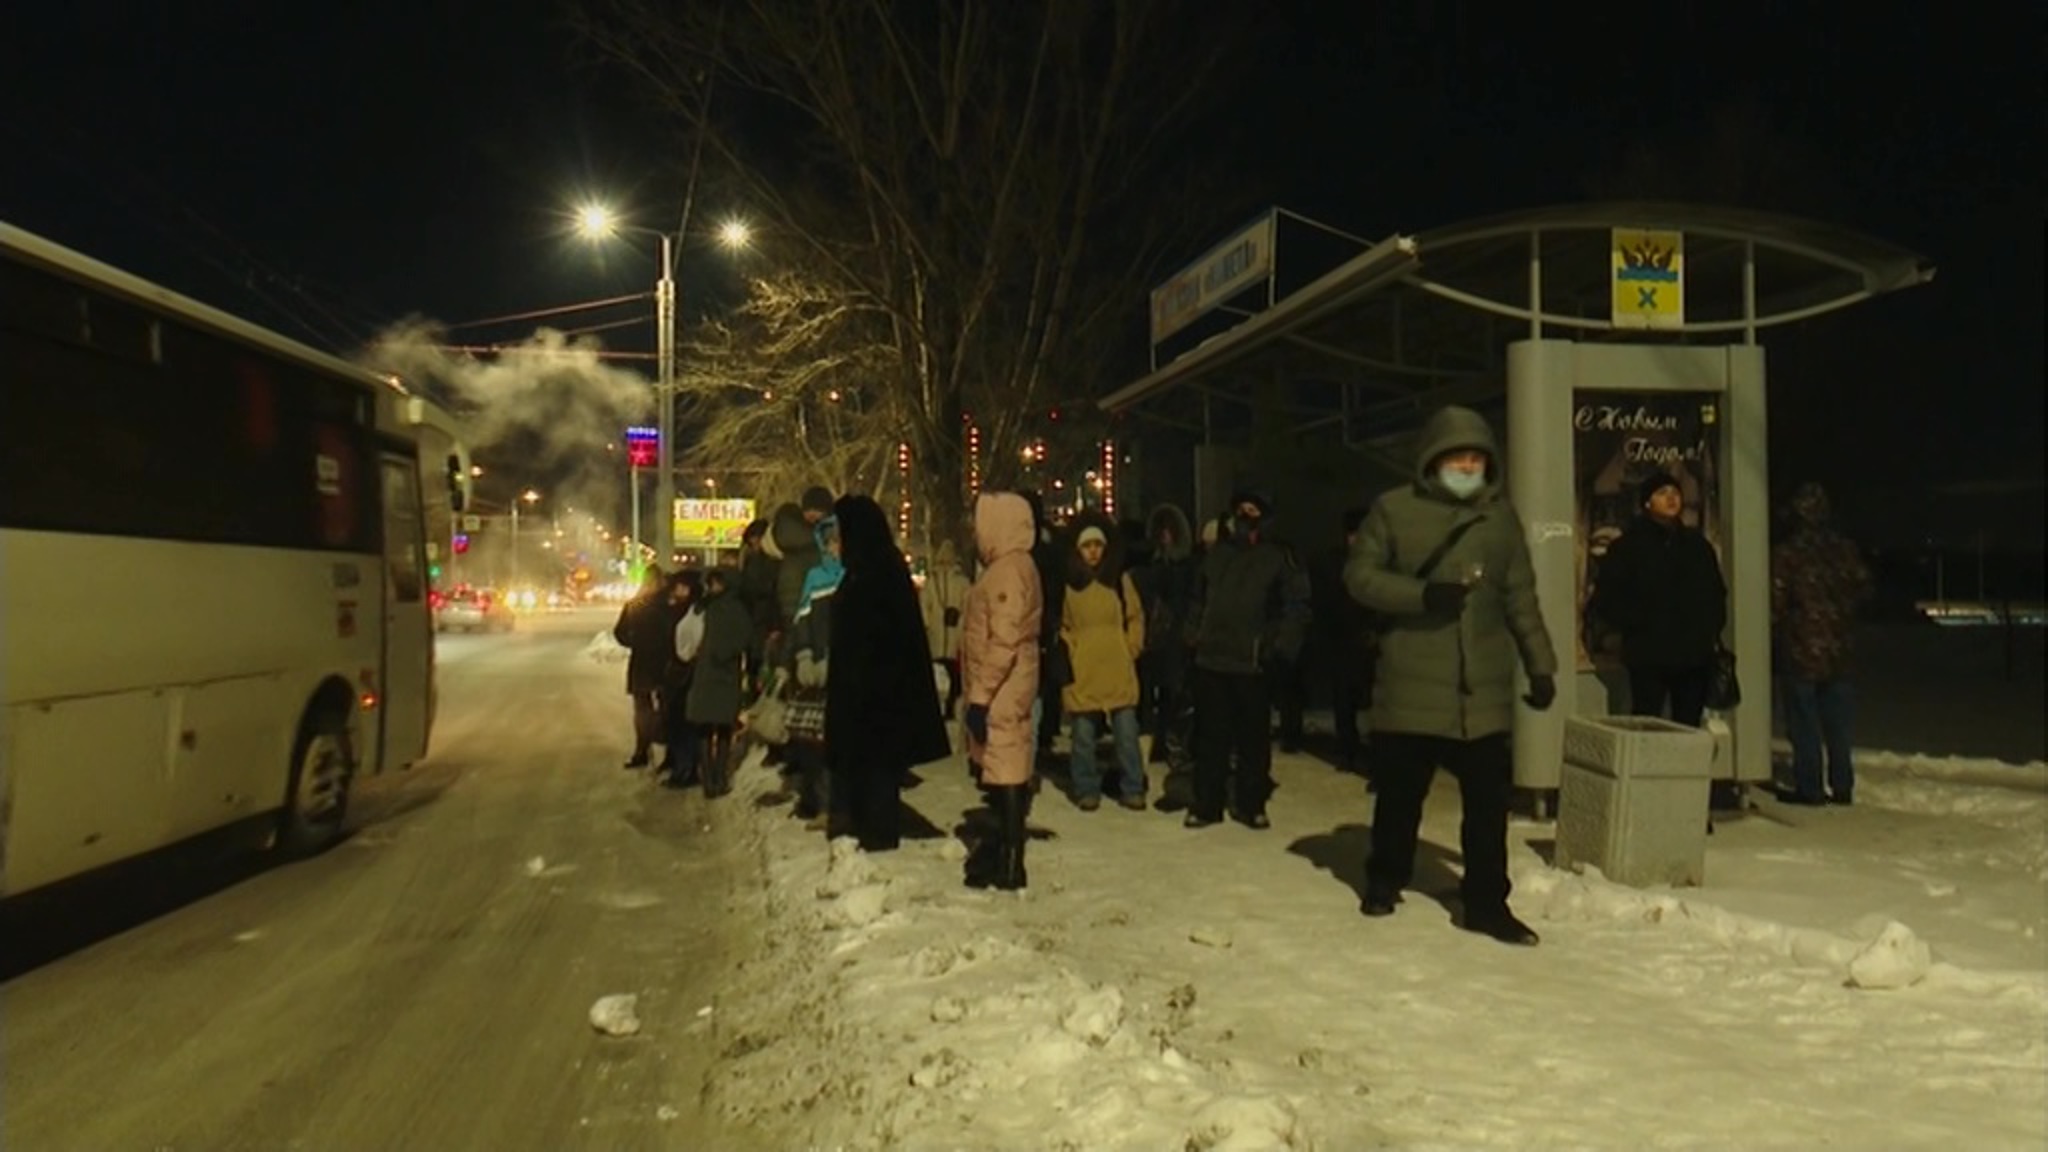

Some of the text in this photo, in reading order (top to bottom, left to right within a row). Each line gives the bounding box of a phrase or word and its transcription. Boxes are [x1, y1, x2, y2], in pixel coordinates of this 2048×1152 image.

[1575, 404, 1678, 431] С Новым
[1623, 436, 1705, 465] Годом!
[673, 502, 751, 521] ЕМЕНА
